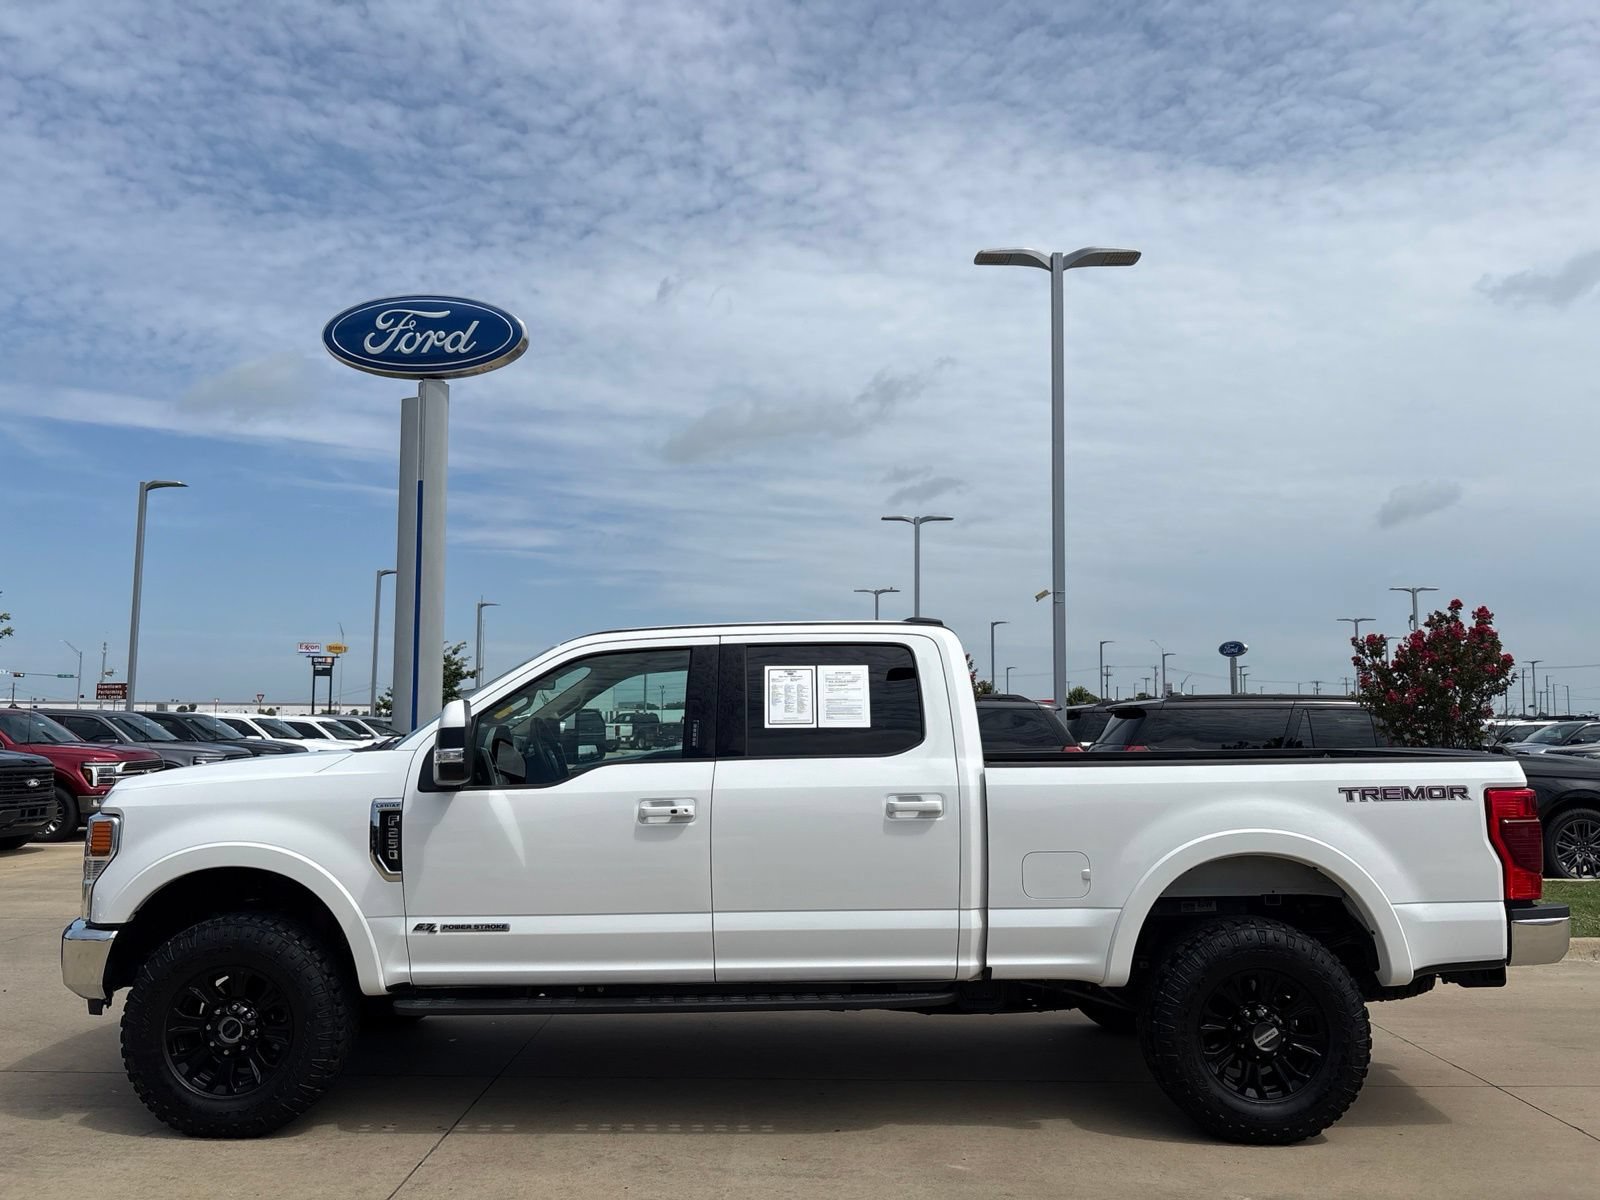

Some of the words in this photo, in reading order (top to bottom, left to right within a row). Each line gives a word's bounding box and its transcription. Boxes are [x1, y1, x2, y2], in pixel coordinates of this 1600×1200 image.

[363, 309, 480, 355] Ford
[299, 643, 320, 652] Exxon
[1338, 785, 1473, 802] TREMOR
[442, 923, 472, 931] POWER
[473, 923, 508, 931] STROKE
